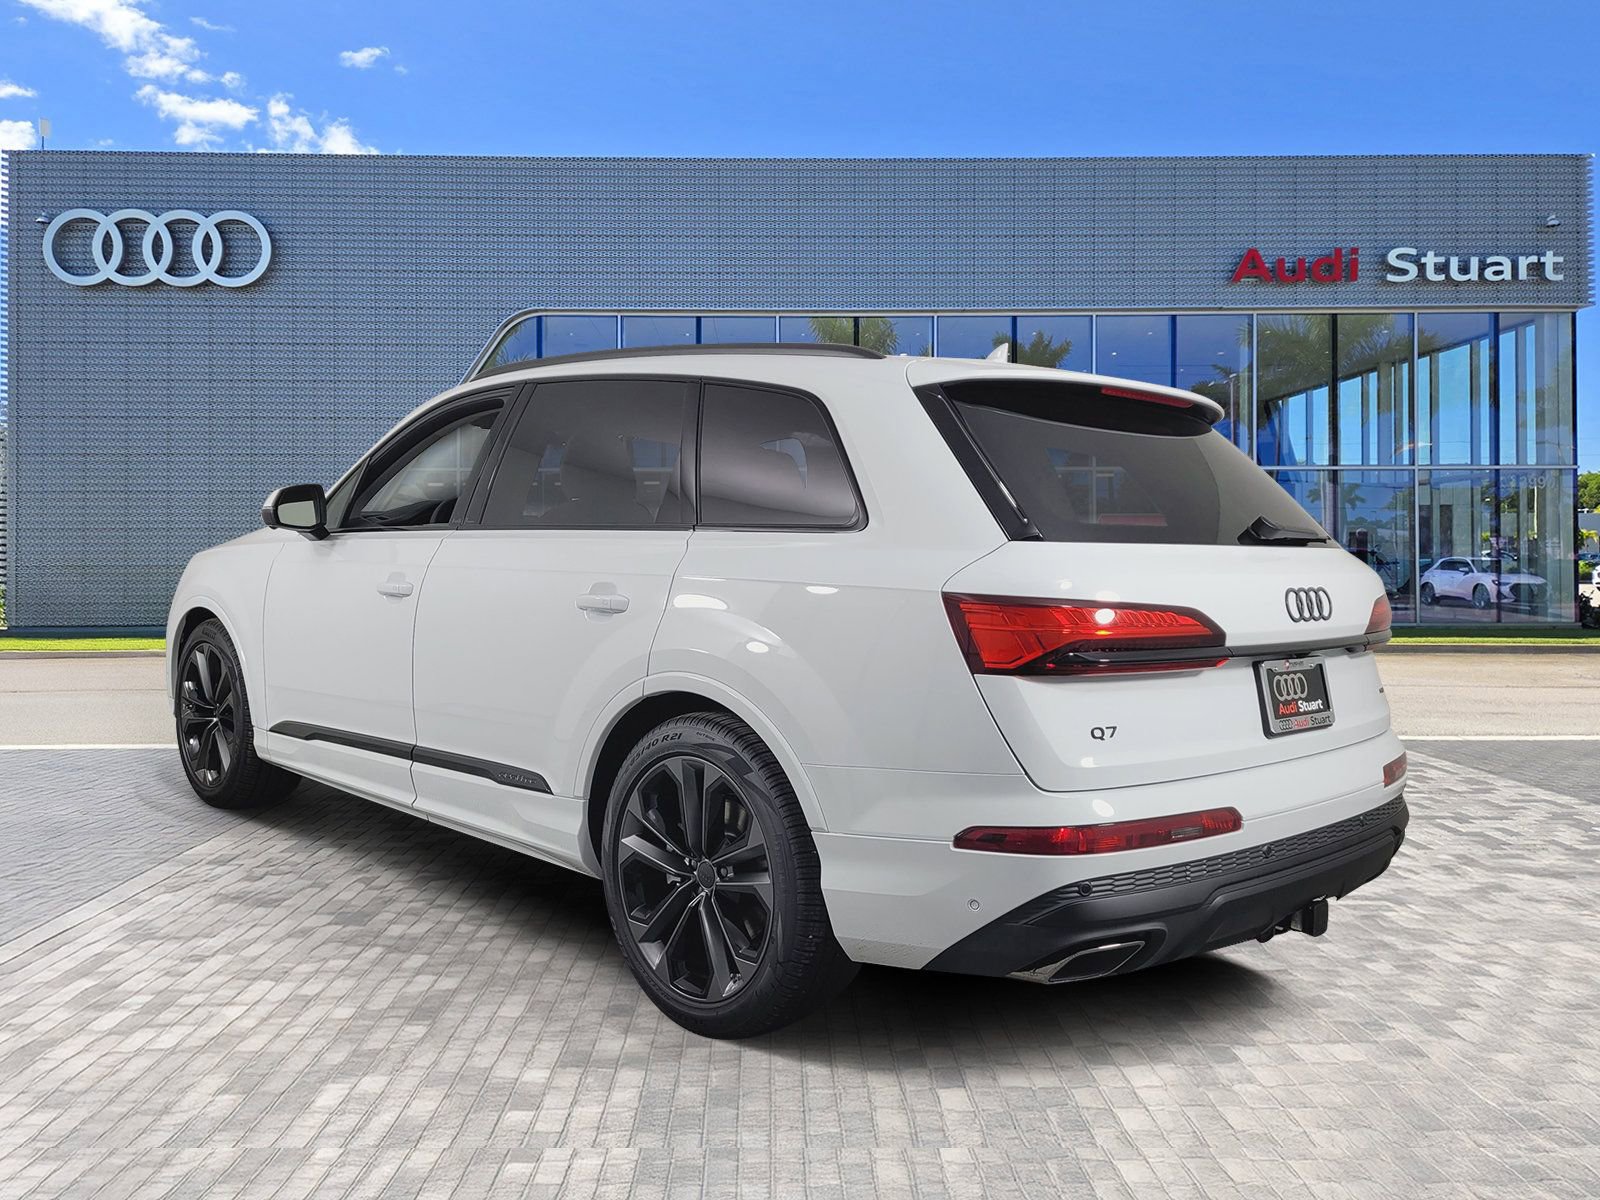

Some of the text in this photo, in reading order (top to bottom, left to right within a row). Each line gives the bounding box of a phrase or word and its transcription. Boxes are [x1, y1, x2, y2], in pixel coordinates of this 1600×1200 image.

[1231, 247, 1564, 283] Audi Stuart
[1279, 699, 1324, 715] Audi Stuart
[1294, 715, 1332, 728] Audi Stuart
[661, 732, 683, 743] R21
[1091, 726, 1118, 741] Q7
